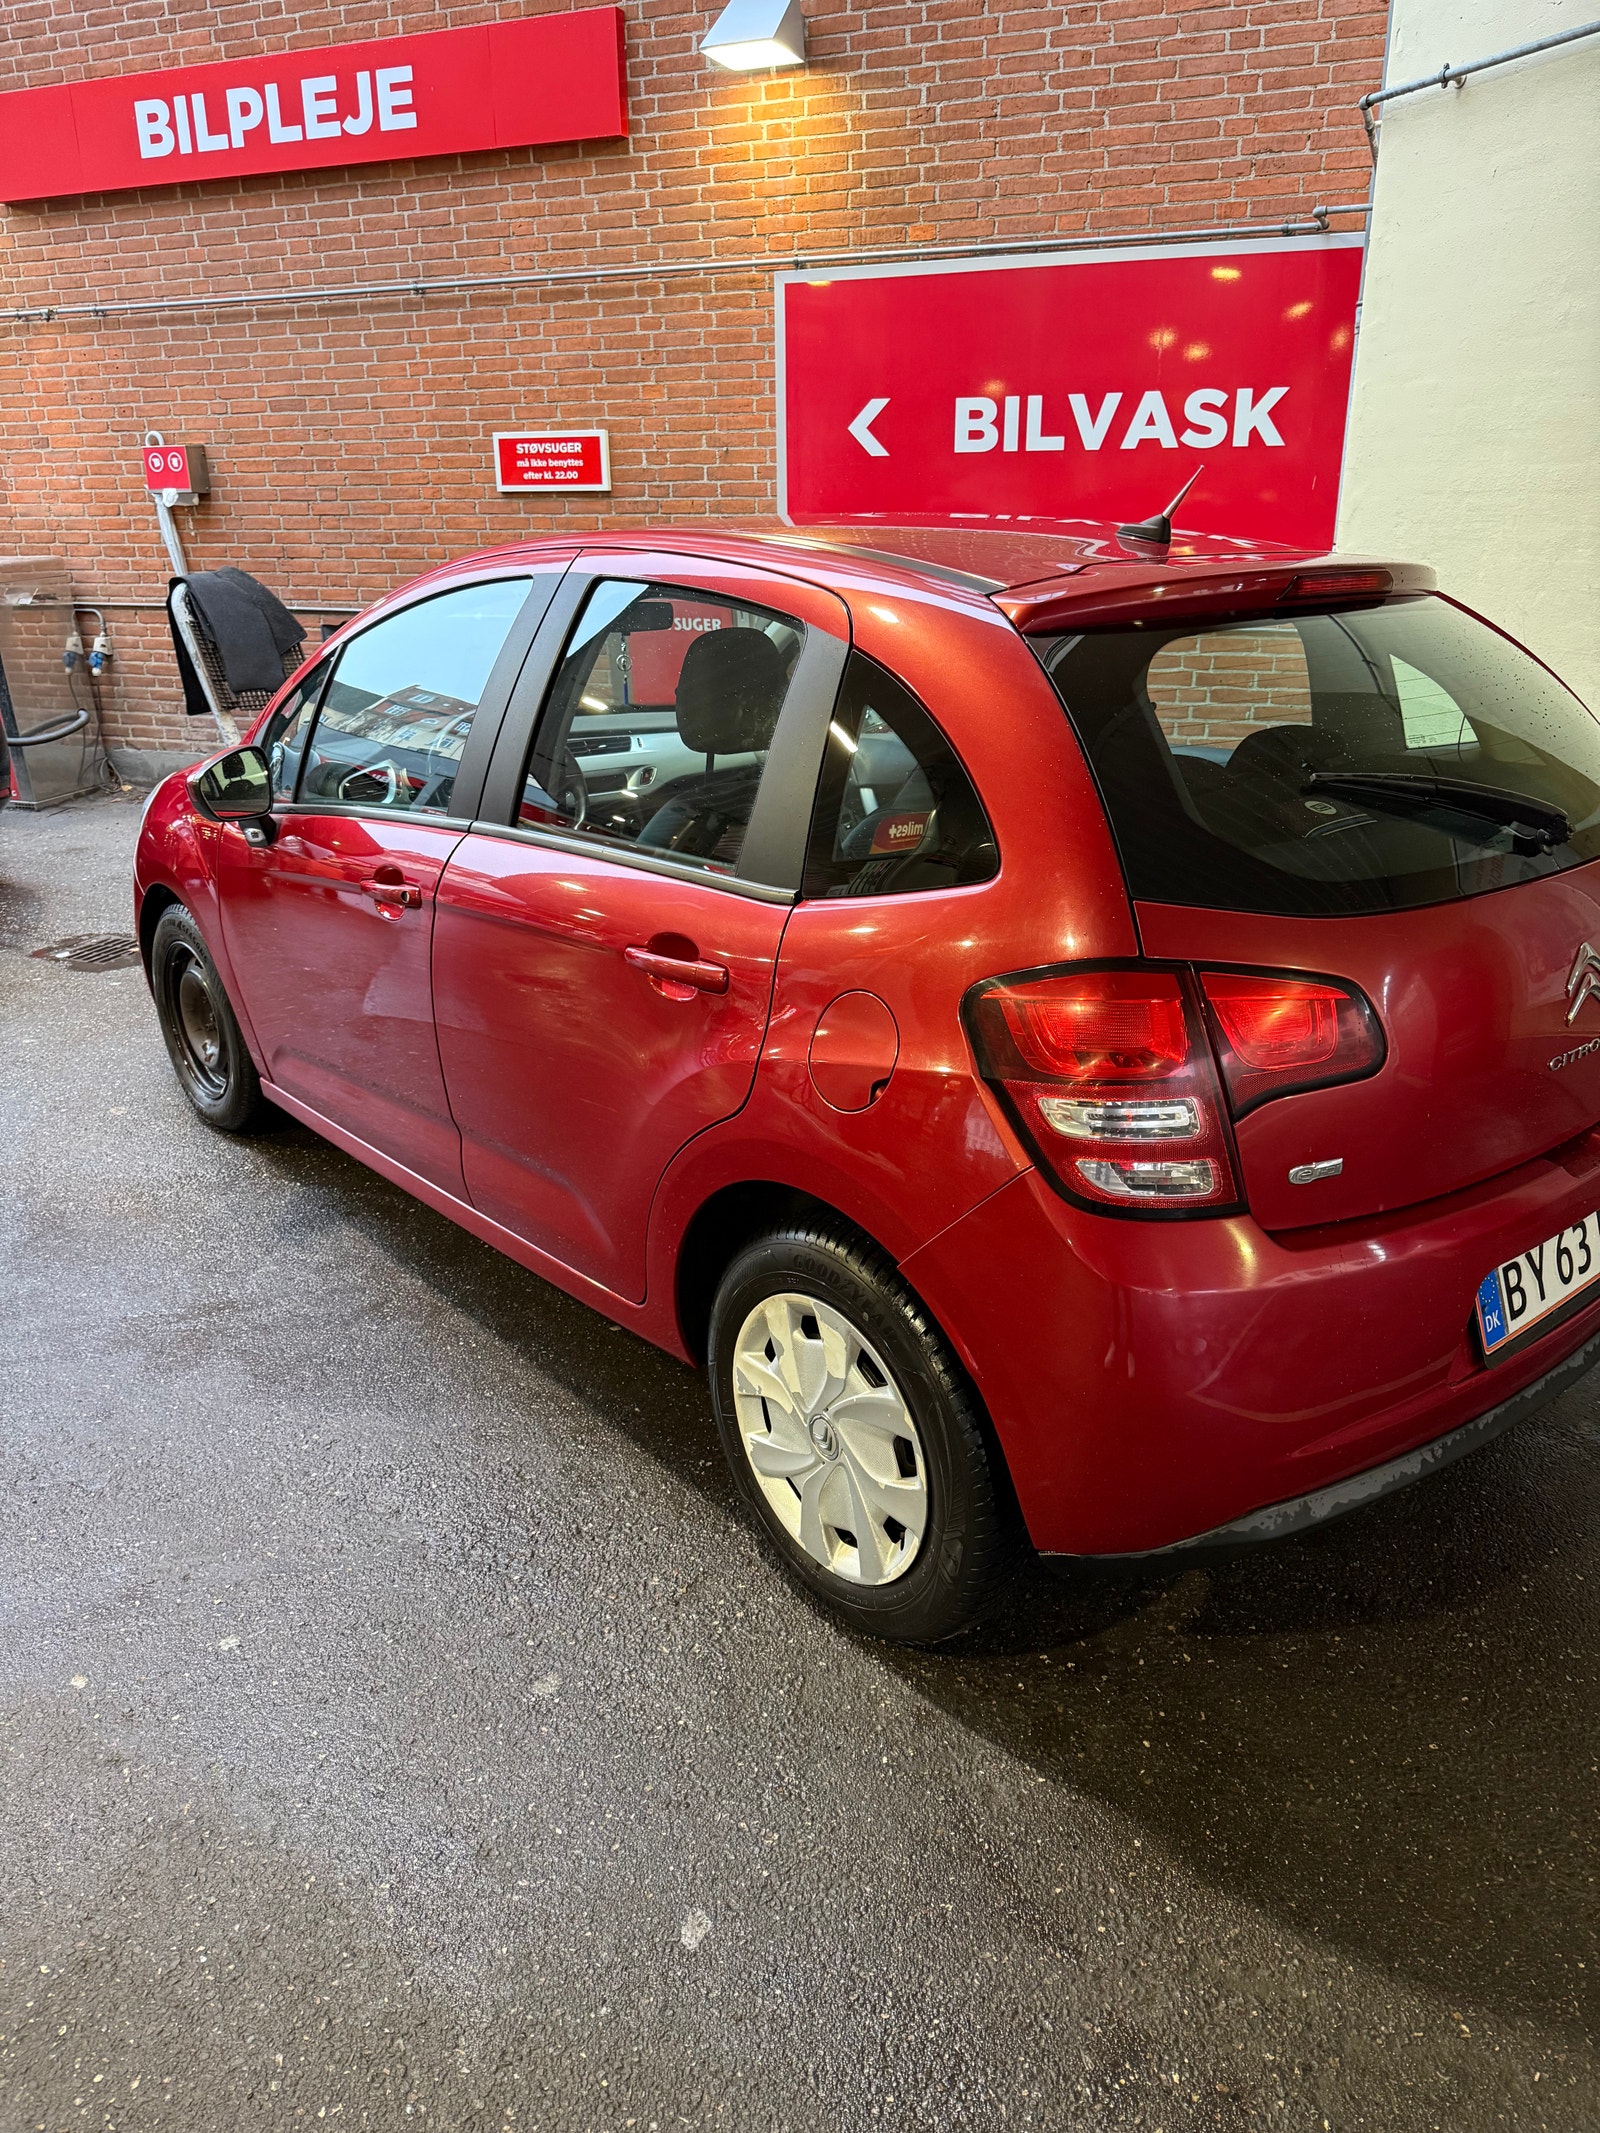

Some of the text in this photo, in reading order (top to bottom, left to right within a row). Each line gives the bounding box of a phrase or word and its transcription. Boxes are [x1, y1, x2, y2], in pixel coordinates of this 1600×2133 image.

[134, 65, 417, 159] BILPLEJE
[954, 387, 1290, 453] BILVASK
[516, 442, 582, 454] STØVSUGER
[516, 458, 583, 468] må ikke benyttes
[523, 471, 578, 480] efter kl. 22.00
[671, 617, 722, 631] SUGER
[1549, 1038, 1600, 1071] CITRO
[1502, 1219, 1592, 1322] BY 63
[1485, 1309, 1501, 1333] DK
